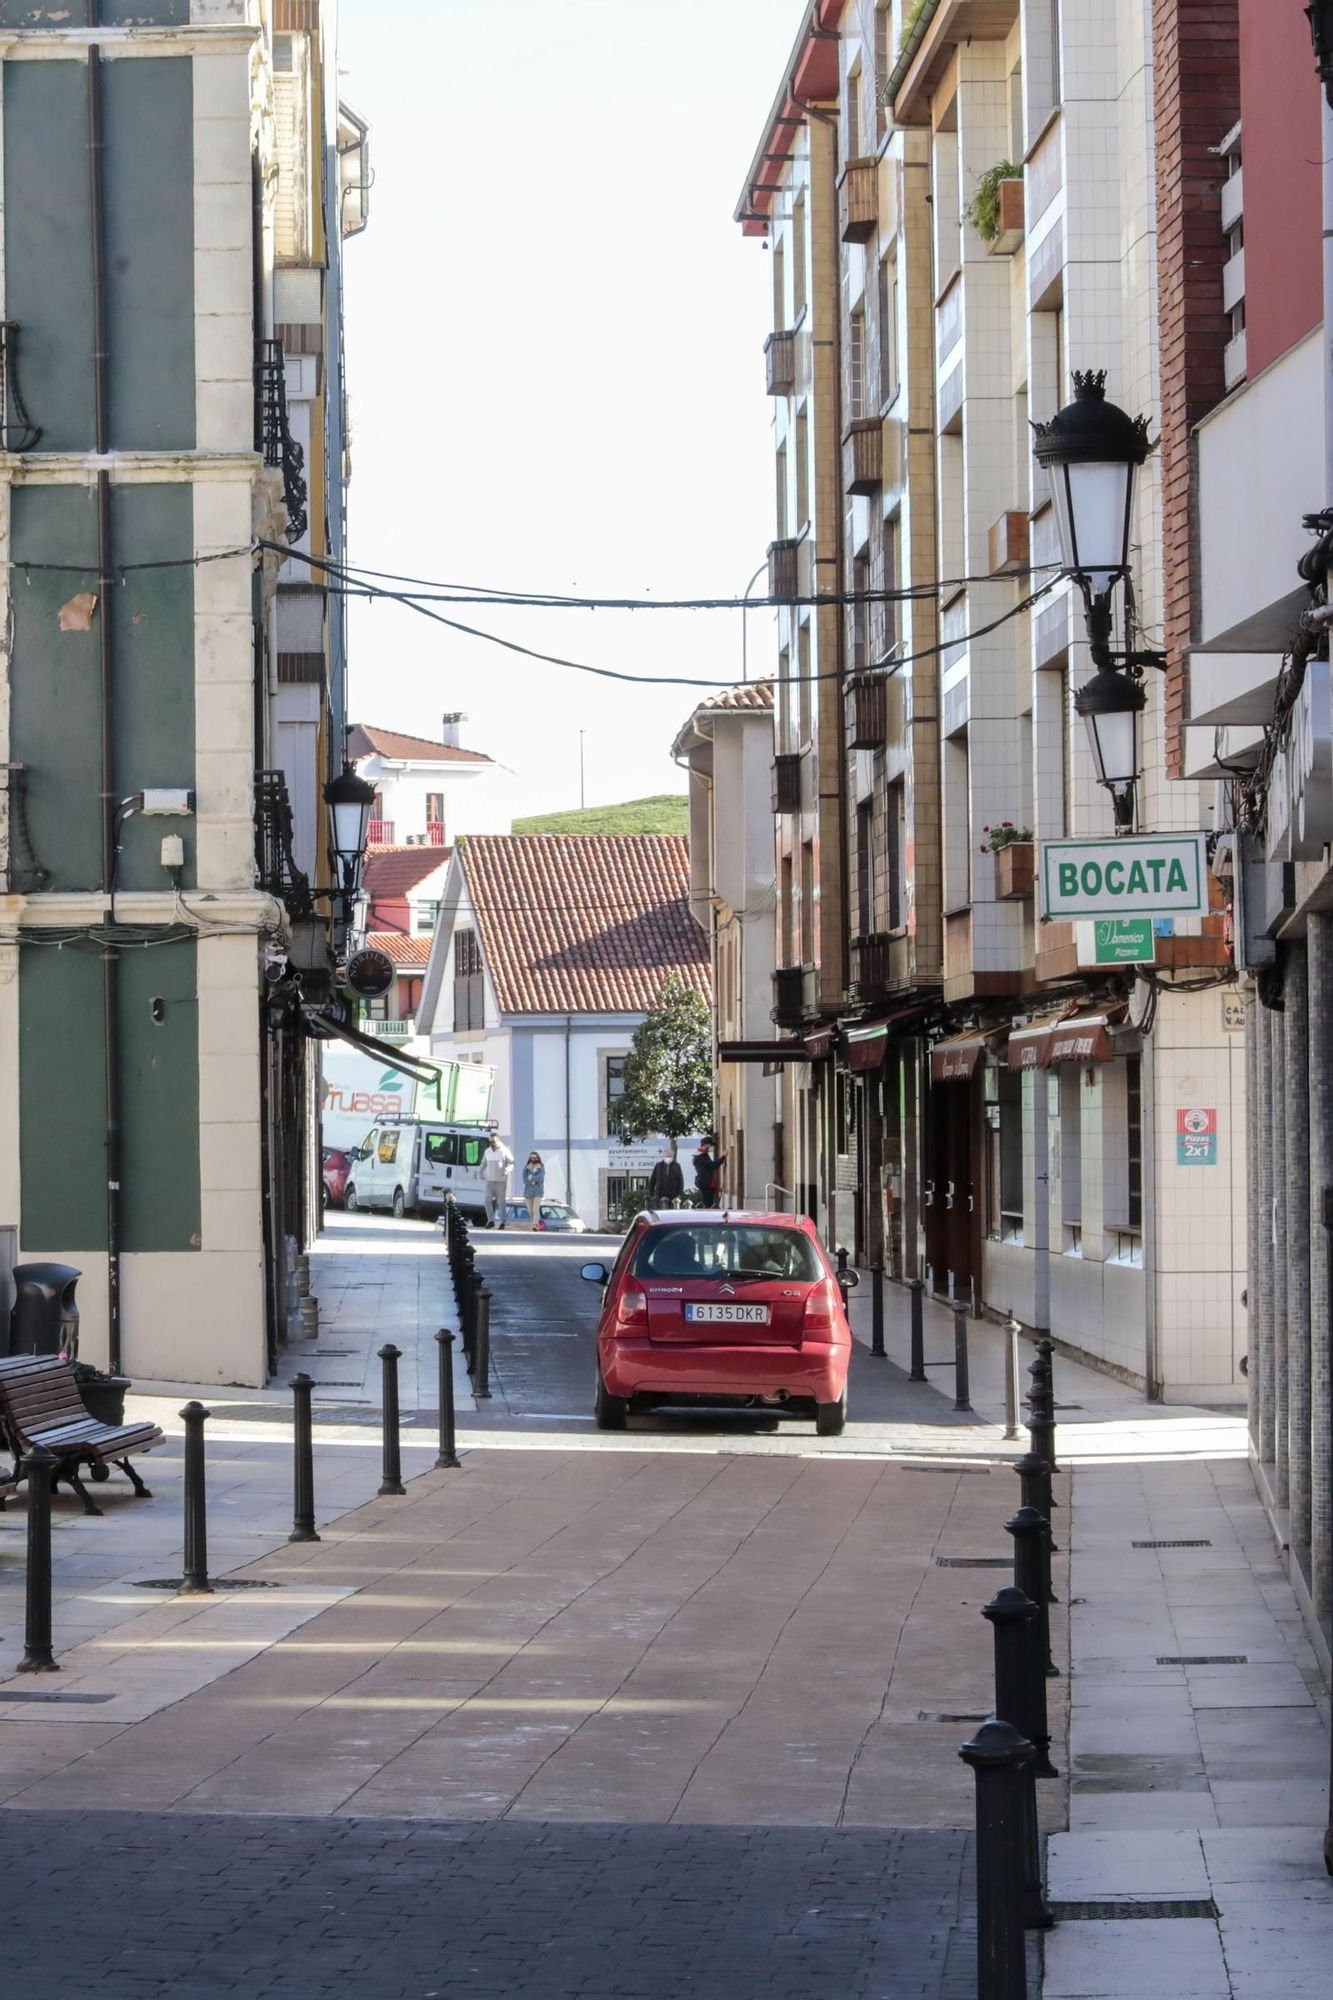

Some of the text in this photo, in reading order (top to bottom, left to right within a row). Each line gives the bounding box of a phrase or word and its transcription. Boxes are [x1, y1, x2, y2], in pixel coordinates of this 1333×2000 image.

[1058, 858, 1188, 897] BOCATA
[1114, 947, 1139, 957] Pizzeria
[349, 951, 392, 977] NORDESTE
[1185, 1134, 1210, 1142] Pizzas
[1185, 1145, 1209, 1157] 2x1
